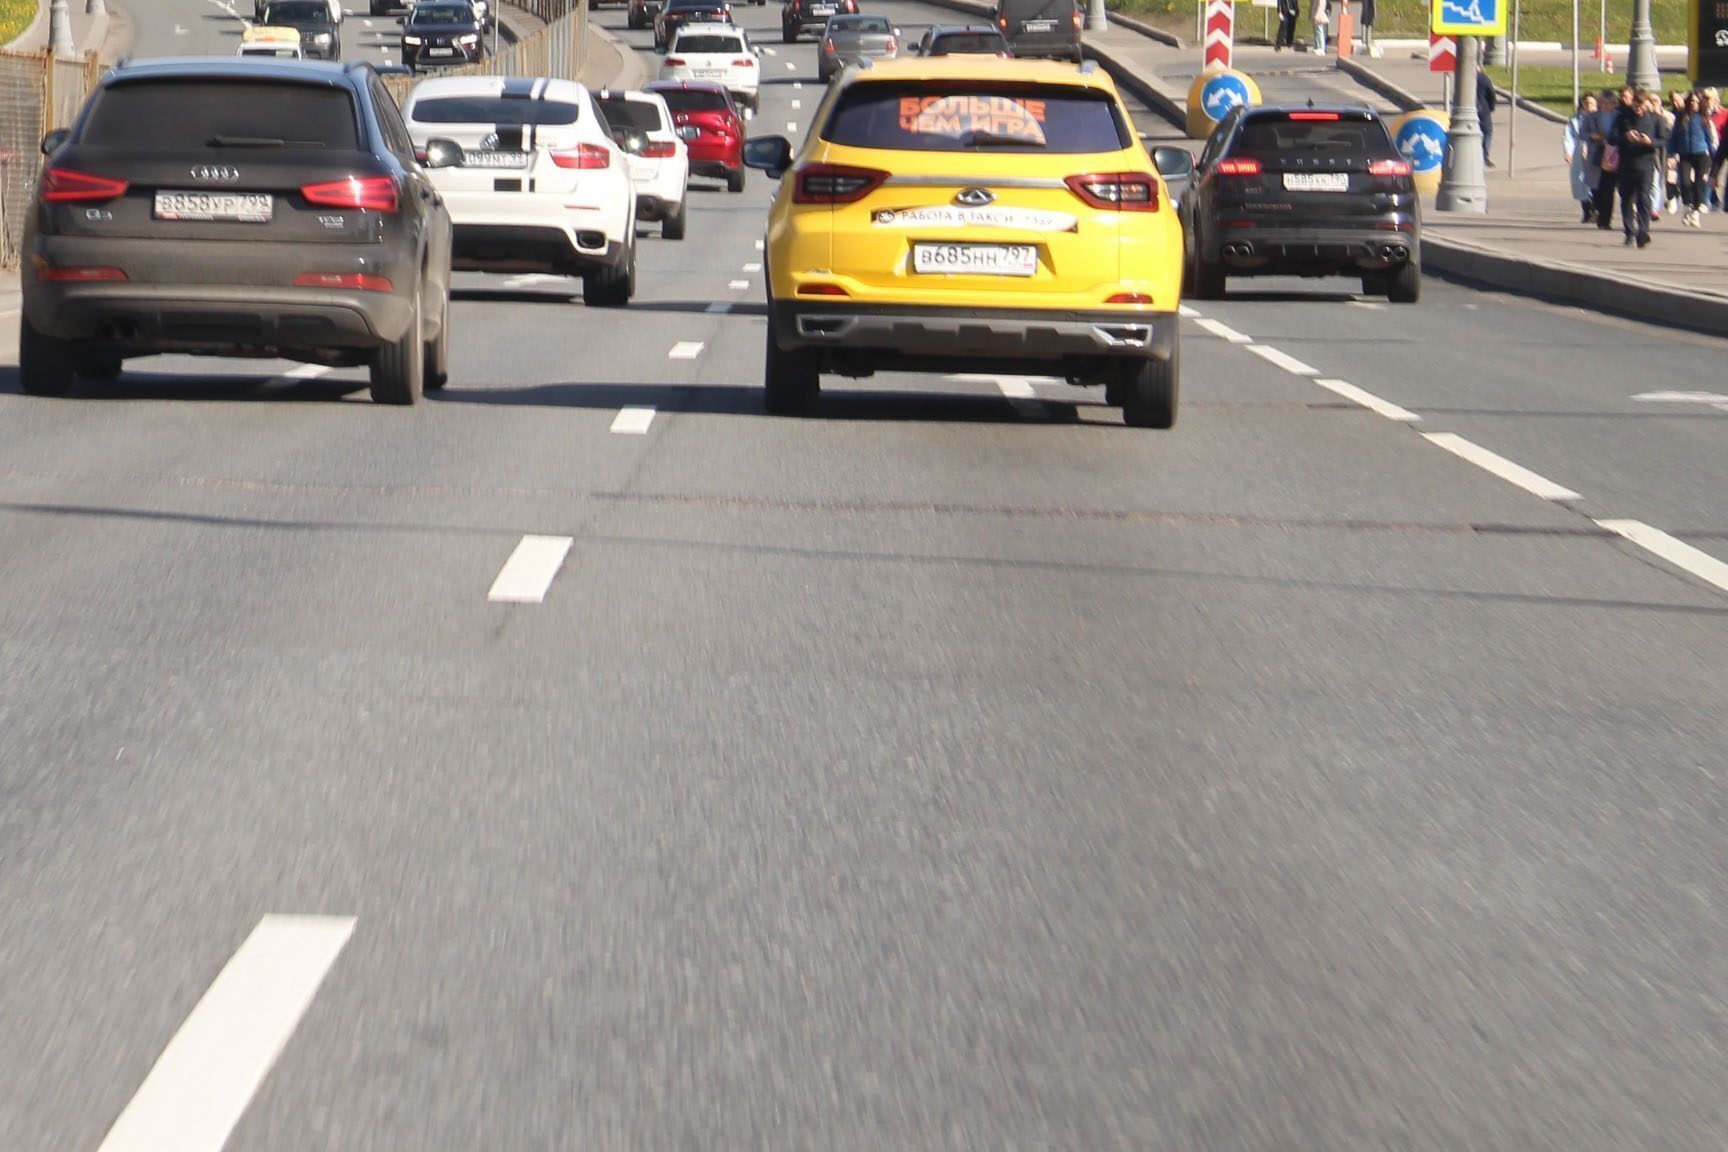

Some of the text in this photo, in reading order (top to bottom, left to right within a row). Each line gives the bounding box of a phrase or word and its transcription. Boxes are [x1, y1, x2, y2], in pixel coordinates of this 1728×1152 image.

[899, 96, 1046, 122] БОЛЬШЕ
[899, 114, 1044, 144] ЧЕМ ИГРА
[902, 210, 953, 222] РАБОТА
[969, 212, 1014, 223] ТАКСИ
